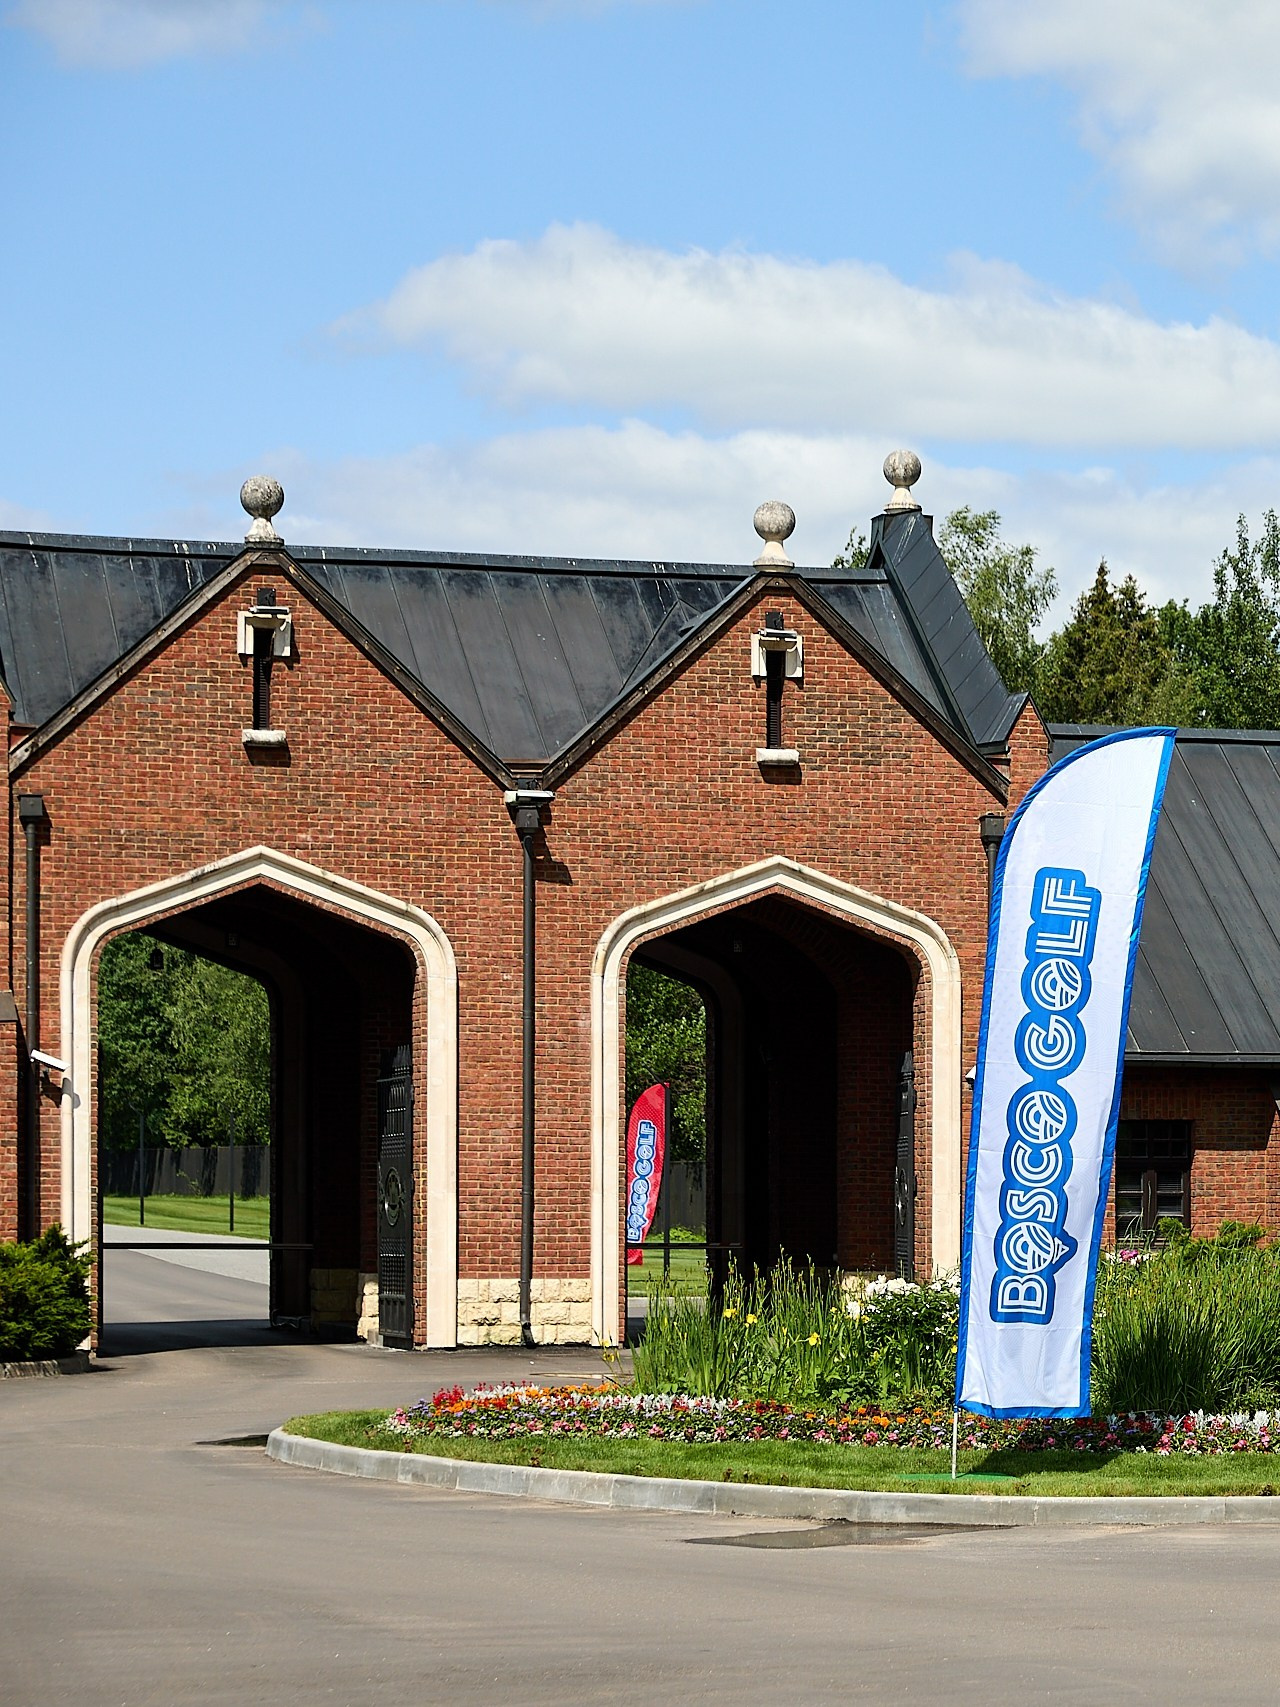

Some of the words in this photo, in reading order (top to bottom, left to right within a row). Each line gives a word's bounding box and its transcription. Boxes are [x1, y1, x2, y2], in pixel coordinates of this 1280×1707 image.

[1026, 878, 1091, 1068] GOLF
[627, 1180, 647, 1240] BOSCO
[636, 1124, 654, 1175] GOLF
[1000, 1091, 1067, 1315] BOSCO
